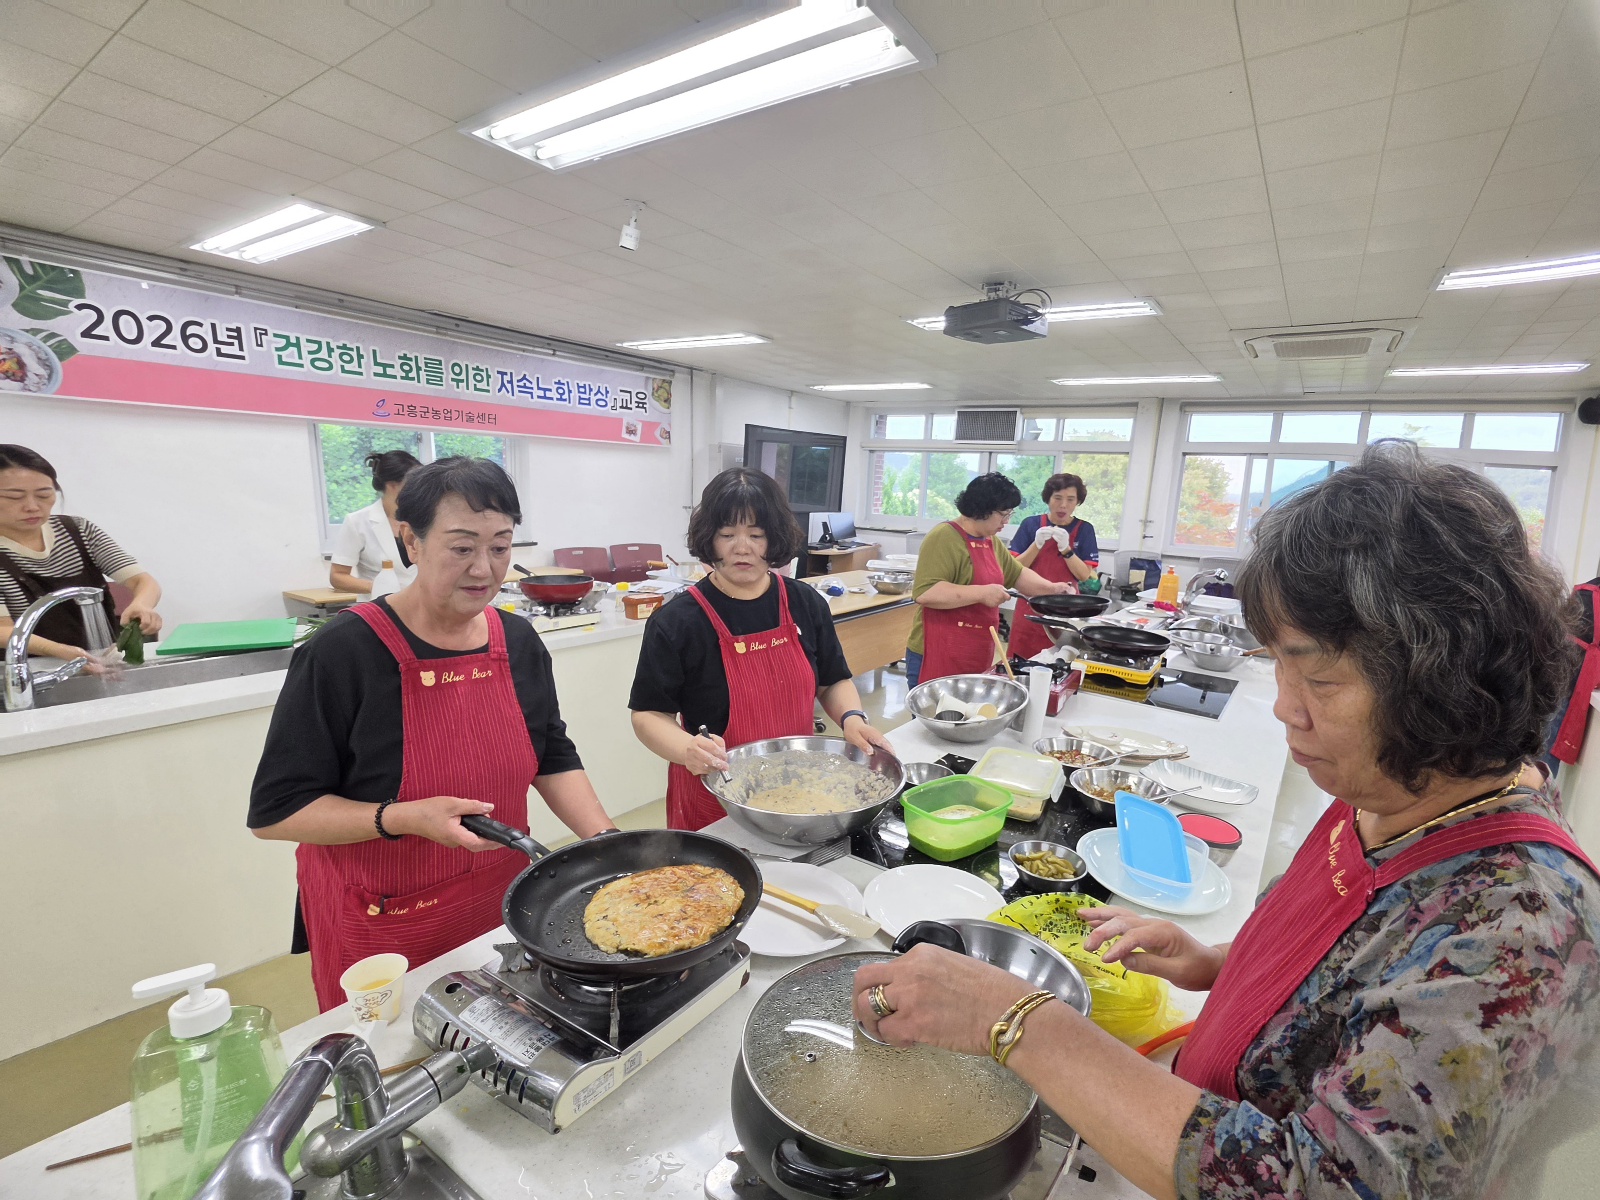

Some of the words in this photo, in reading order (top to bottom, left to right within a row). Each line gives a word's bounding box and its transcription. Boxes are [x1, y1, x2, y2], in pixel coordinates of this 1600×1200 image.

[74, 303, 246, 361] 2026년
[372, 349, 445, 387] 노화를
[450, 362, 492, 393] 위한
[497, 370, 573, 404] 저속노화
[393, 403, 497, 425] 고흥군농업기술센터
[750, 641, 767, 651] Blue
[441, 671, 465, 683] Blue
[472, 668, 493, 679] Bear
[1332, 869, 1348, 896] Bea
